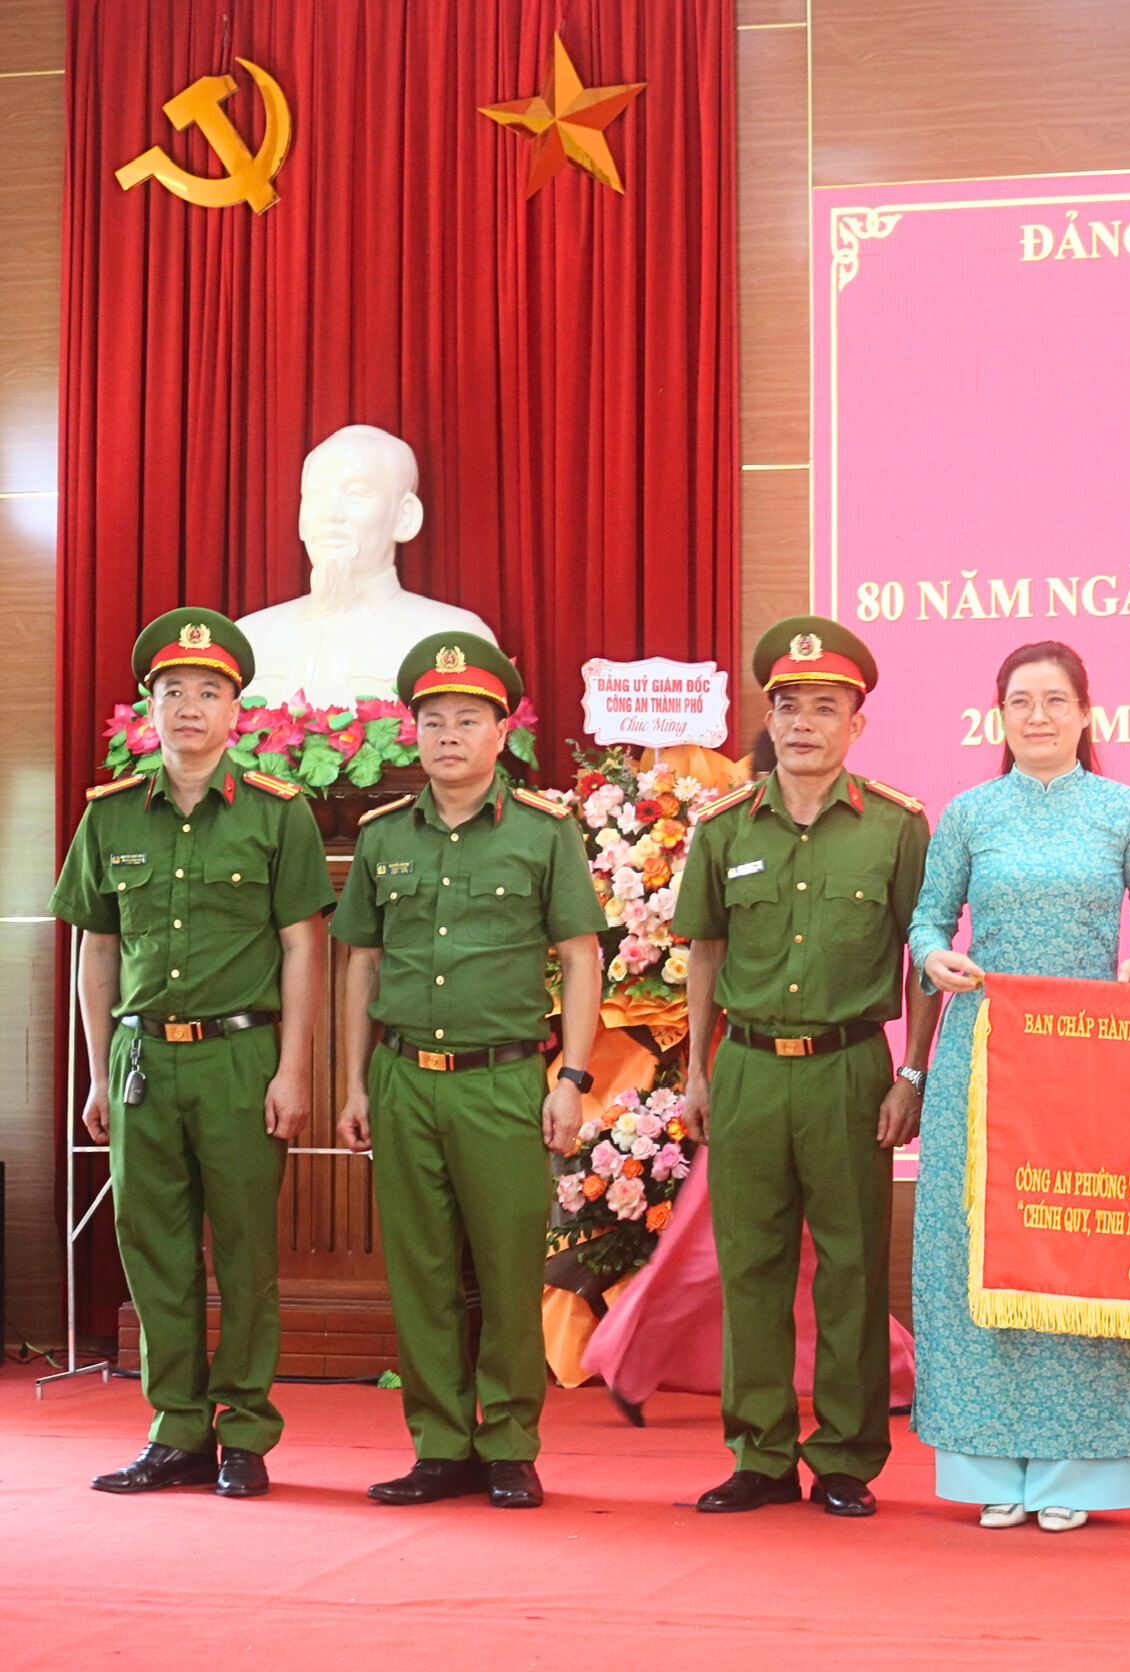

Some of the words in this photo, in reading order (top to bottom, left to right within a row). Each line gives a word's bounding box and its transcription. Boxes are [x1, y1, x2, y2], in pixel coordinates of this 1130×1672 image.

[856, 581, 905, 622] 80
[916, 568, 1034, 621] NĂM
[598, 675, 630, 692] ĐẢNG
[634, 675, 648, 692] UỶ
[652, 676, 682, 693] GIÁM
[686, 674, 710, 692] ĐỐC
[606, 695, 632, 712] CÔNG
[635, 698, 648, 712] AN
[651, 695, 681, 713] THÀNH
[684, 693, 703, 714] PHỐ
[620, 716, 650, 732] Chúc
[652, 717, 688, 736] Mừng
[960, 707, 1005, 746] 20
[1023, 1013, 1054, 1035] BAN
[1056, 1008, 1095, 1038] CHẤP
[1015, 1161, 1051, 1193] CÔNG
[1052, 1170, 1073, 1195] AN
[1073, 1166, 1127, 1200] PHƯỜNG
[1064, 1207, 1091, 1237] QUY,
[1095, 1210, 1124, 1234] TINH
